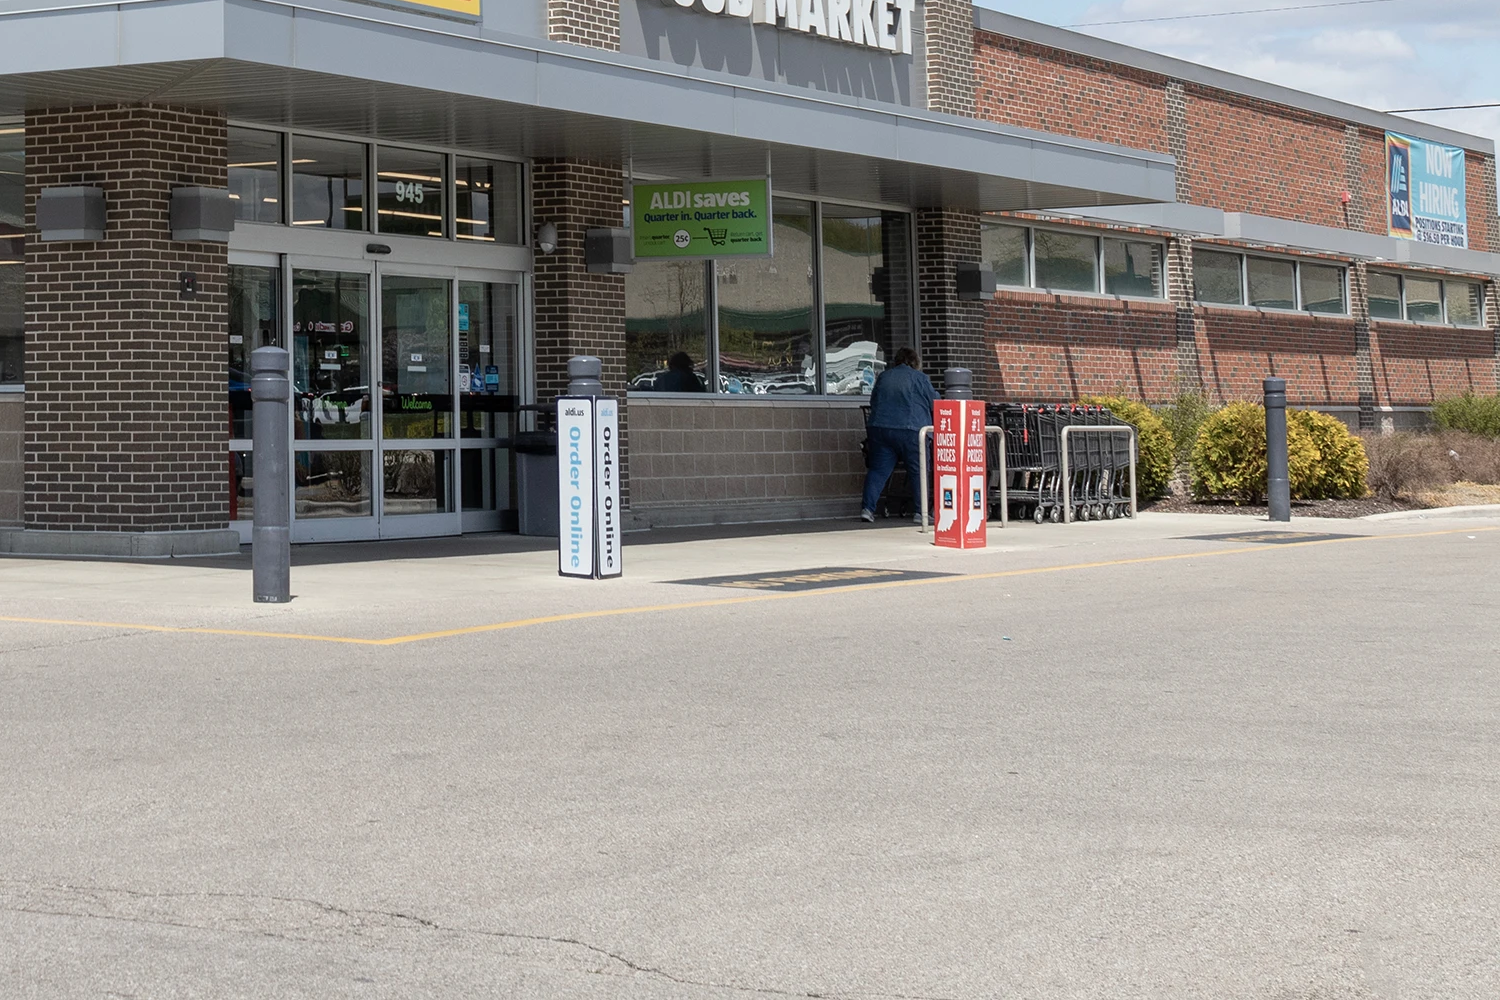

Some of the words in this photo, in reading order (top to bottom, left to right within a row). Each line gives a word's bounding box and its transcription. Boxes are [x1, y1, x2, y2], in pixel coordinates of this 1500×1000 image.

[1425, 143, 1453, 179] NOW
[395, 180, 424, 204] 945
[650, 191, 691, 210] ALDI
[693, 191, 750, 208] saves
[1419, 181, 1460, 219] HIRING
[644, 212, 678, 224] Quarter
[680, 211, 692, 221] in.
[694, 210, 730, 222] Quarter
[731, 209, 757, 219] back.
[1415, 216, 1441, 231] POSITIONS
[1441, 221, 1464, 235] STARTING
[675, 234, 689, 243] 25¢
[401, 395, 433, 410] Welcome
[565, 407, 585, 416] aldi.us
[569, 426, 582, 490] Order
[603, 426, 612, 490] Order
[570, 495, 583, 568] Online
[604, 495, 614, 568] Online
